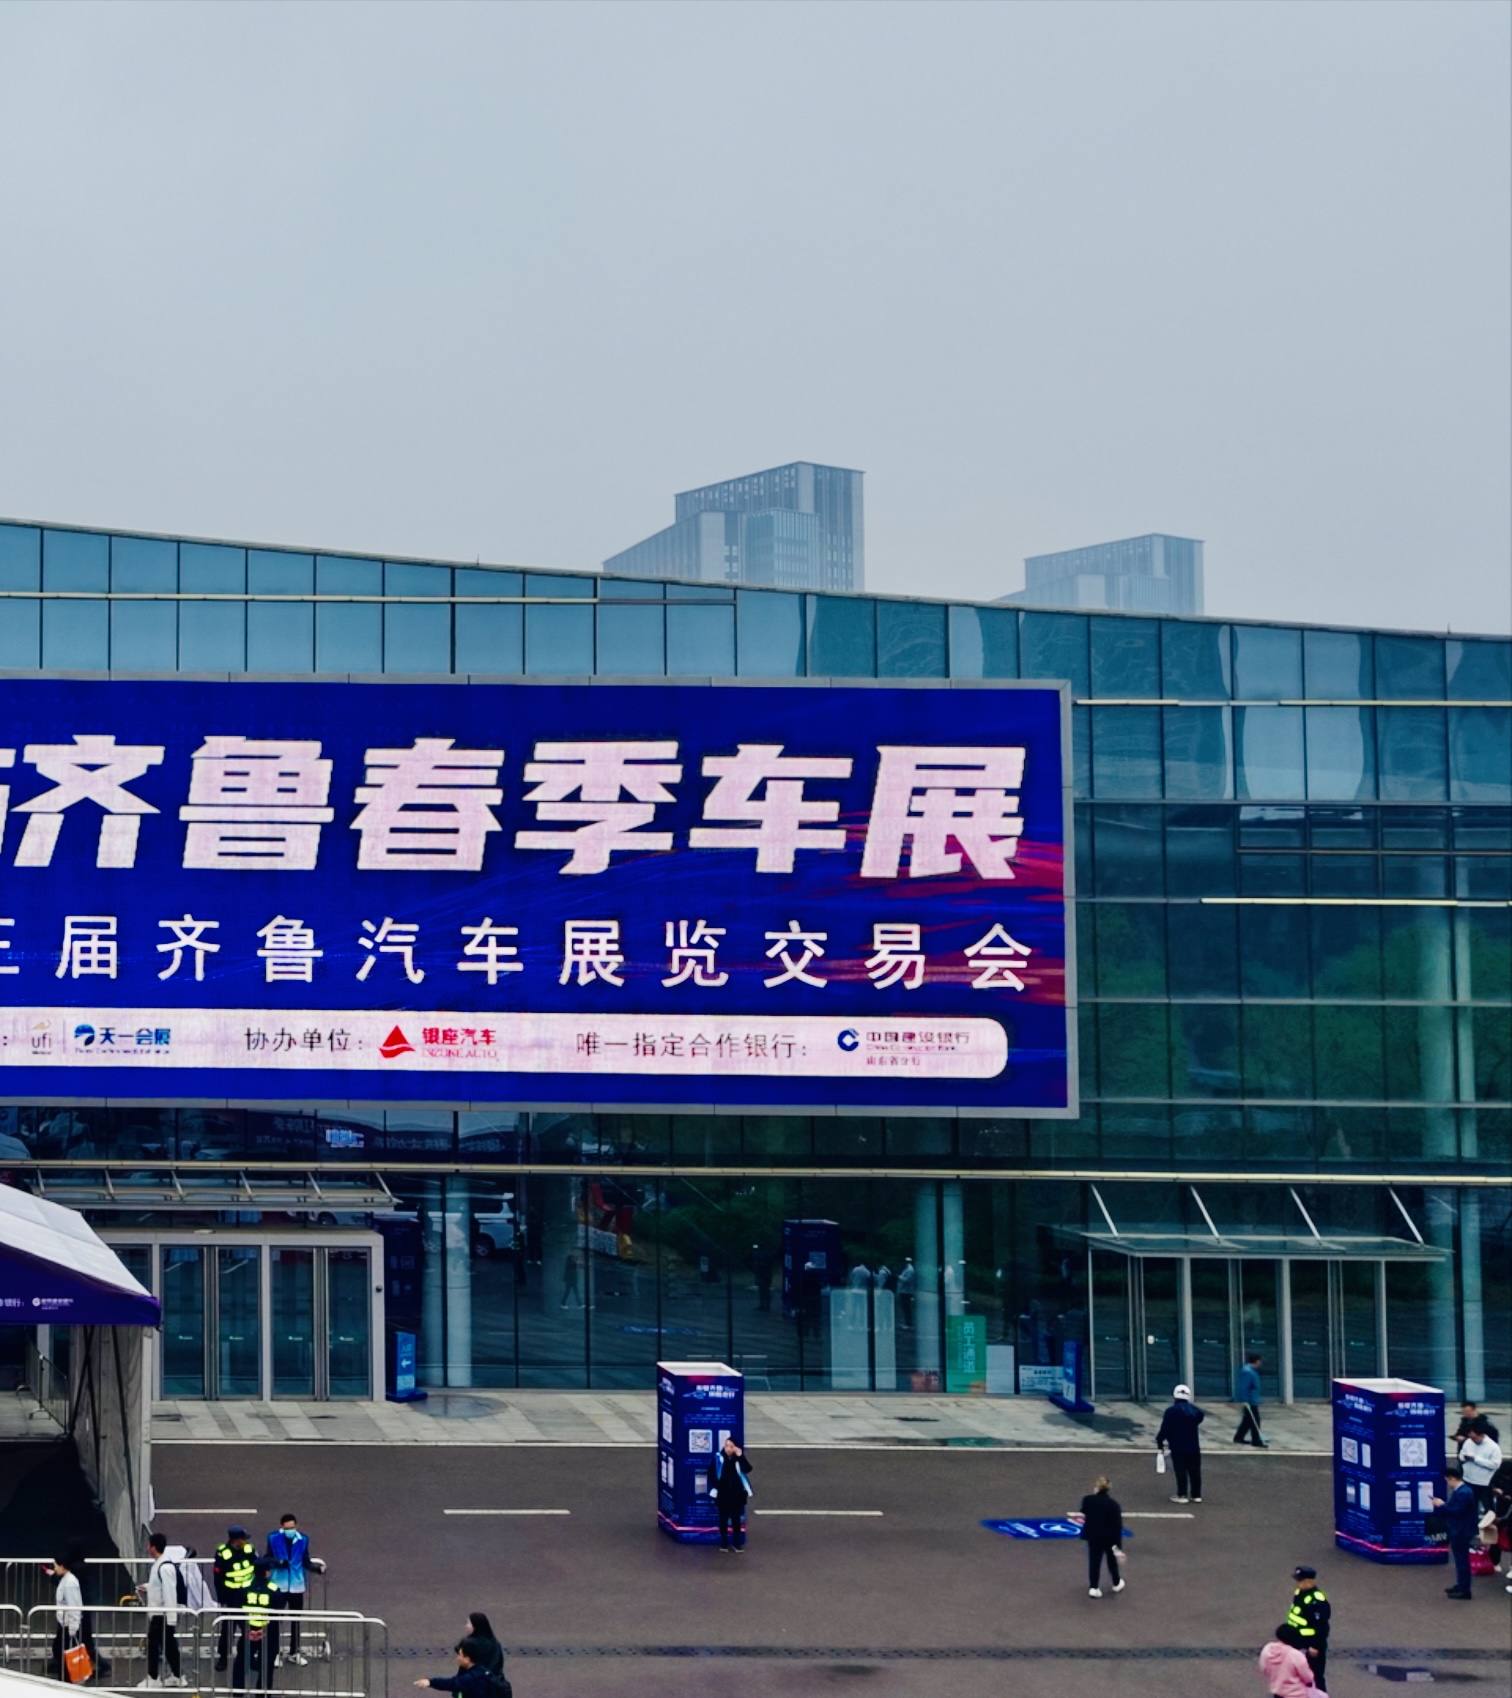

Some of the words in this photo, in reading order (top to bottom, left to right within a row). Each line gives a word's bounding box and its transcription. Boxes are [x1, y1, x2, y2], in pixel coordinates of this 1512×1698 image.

[99, 1027, 172, 1046] 天一会展
[244, 1027, 363, 1052] 协办单位：
[422, 1027, 497, 1046] 银座汽车
[575, 1031, 808, 1060] 唯一指定合作银行：
